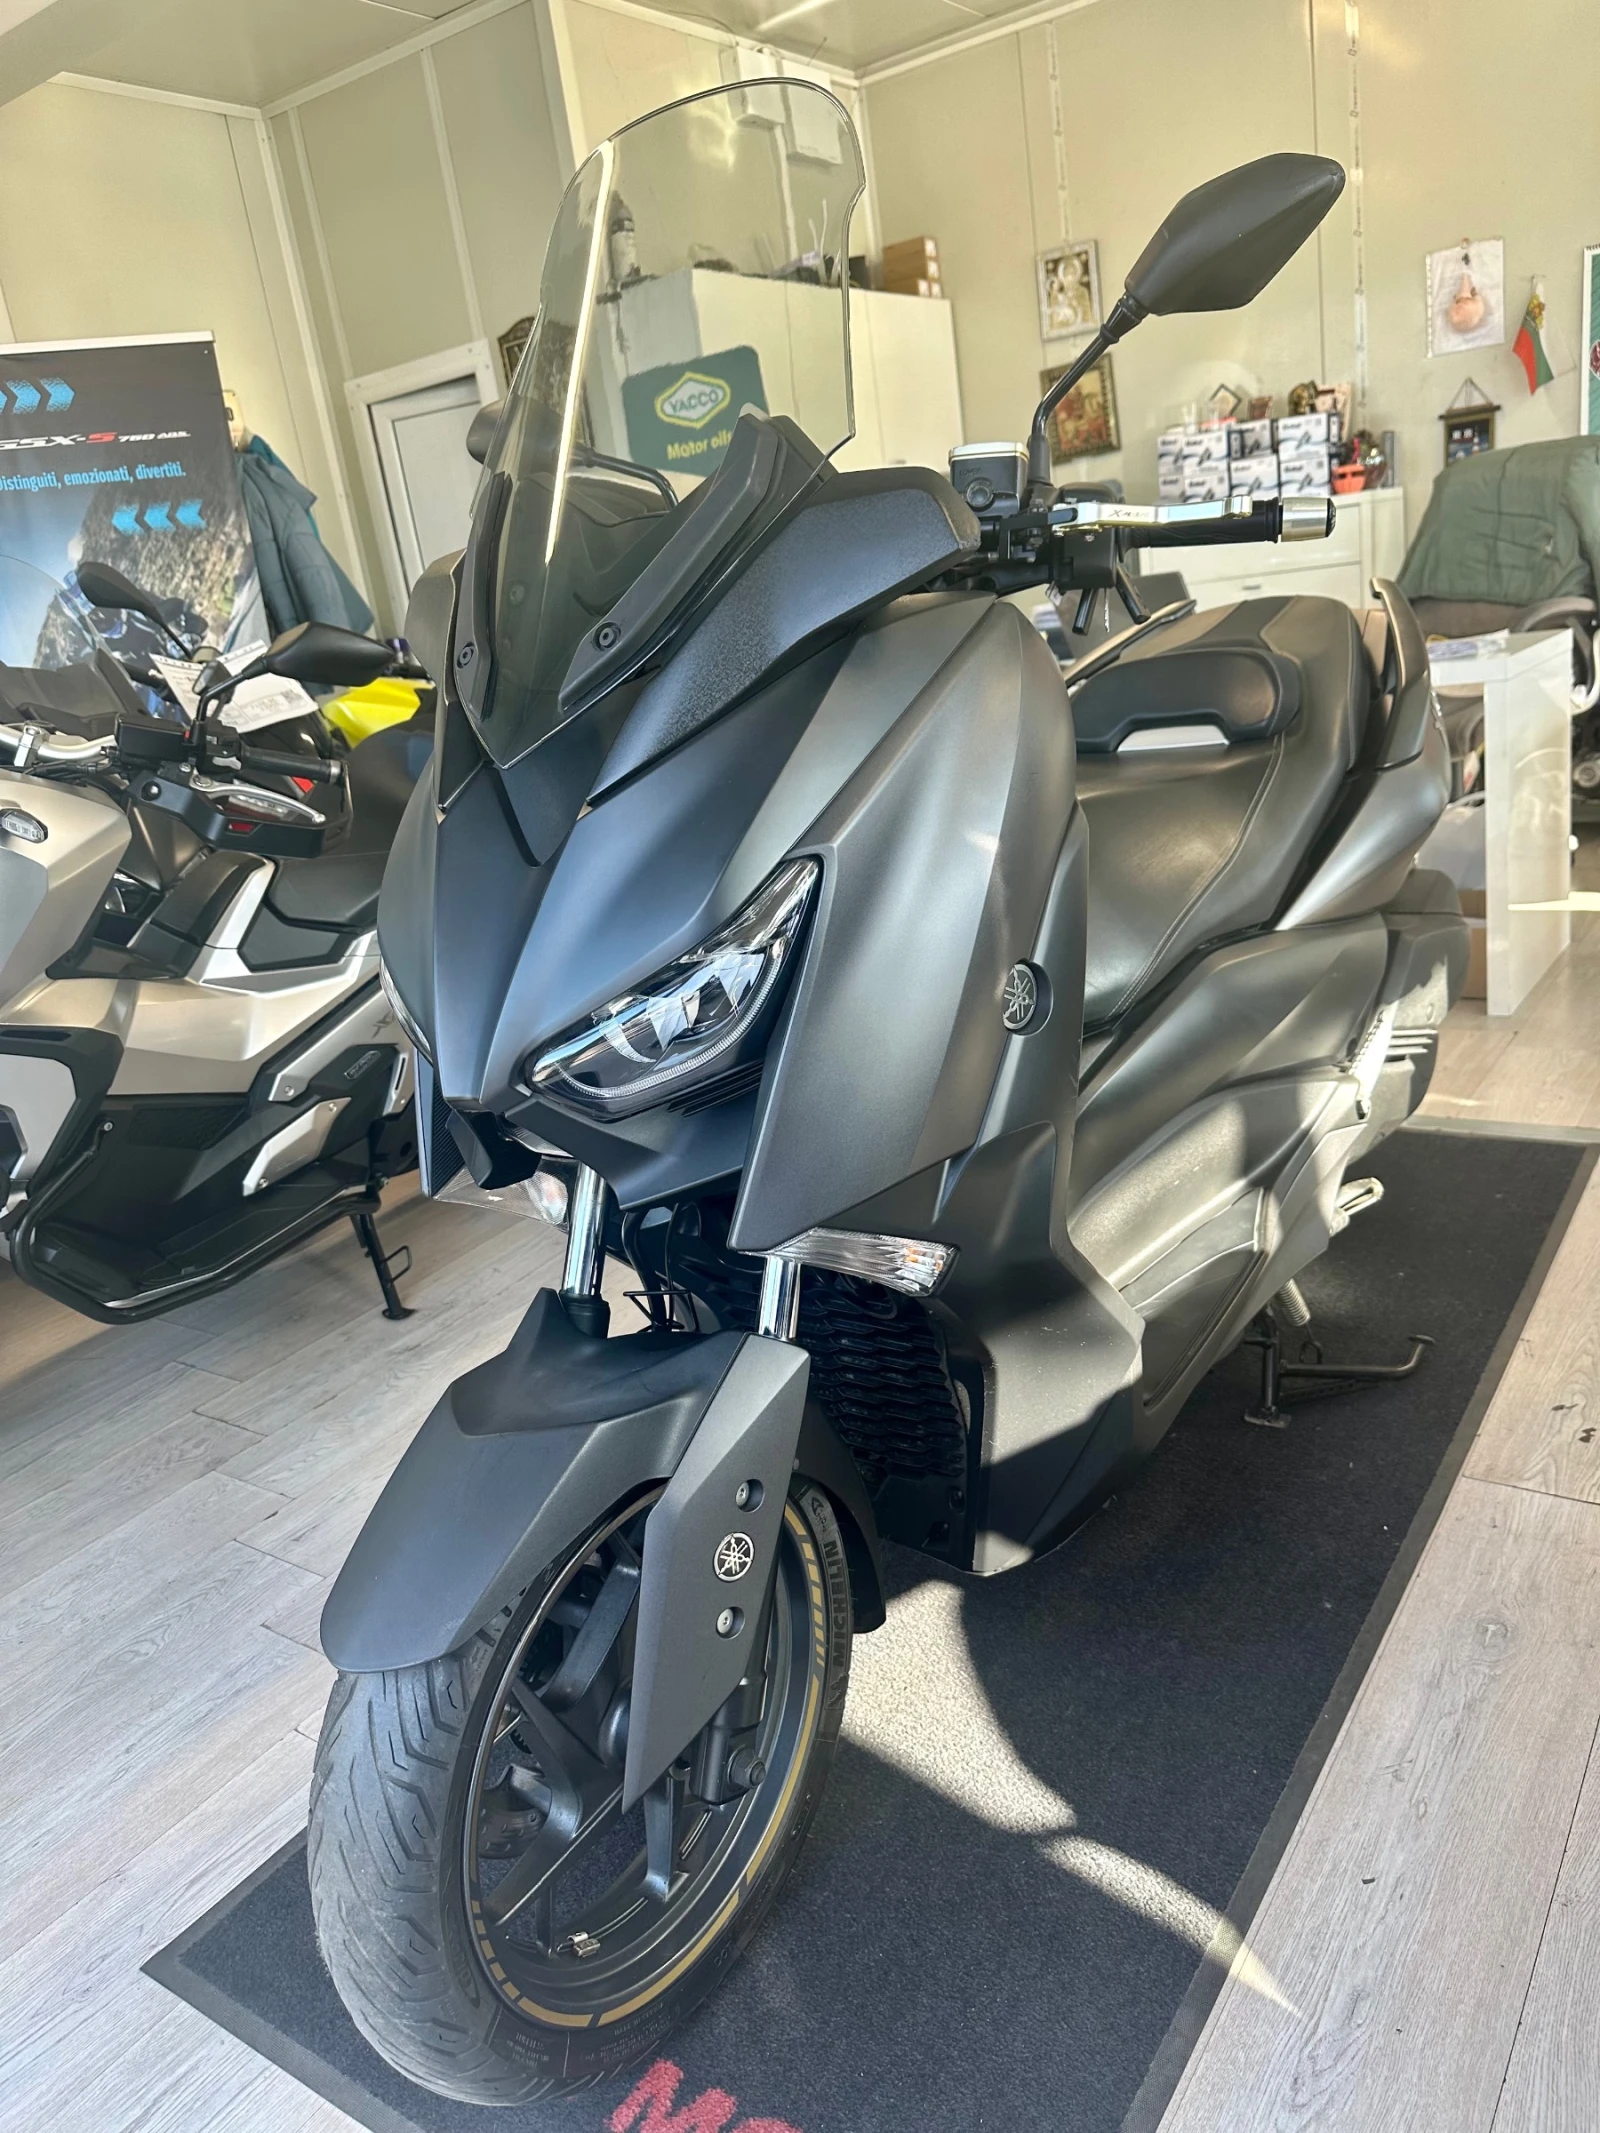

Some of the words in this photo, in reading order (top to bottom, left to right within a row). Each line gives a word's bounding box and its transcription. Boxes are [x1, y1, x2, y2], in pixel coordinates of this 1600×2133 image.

[669, 388, 720, 414] YACCO
[666, 438, 709, 460] Motor
[64, 465, 134, 486] emozionati,
[135, 460, 187, 480] divertiti.
[823, 1539, 847, 1668] MICHELIN
